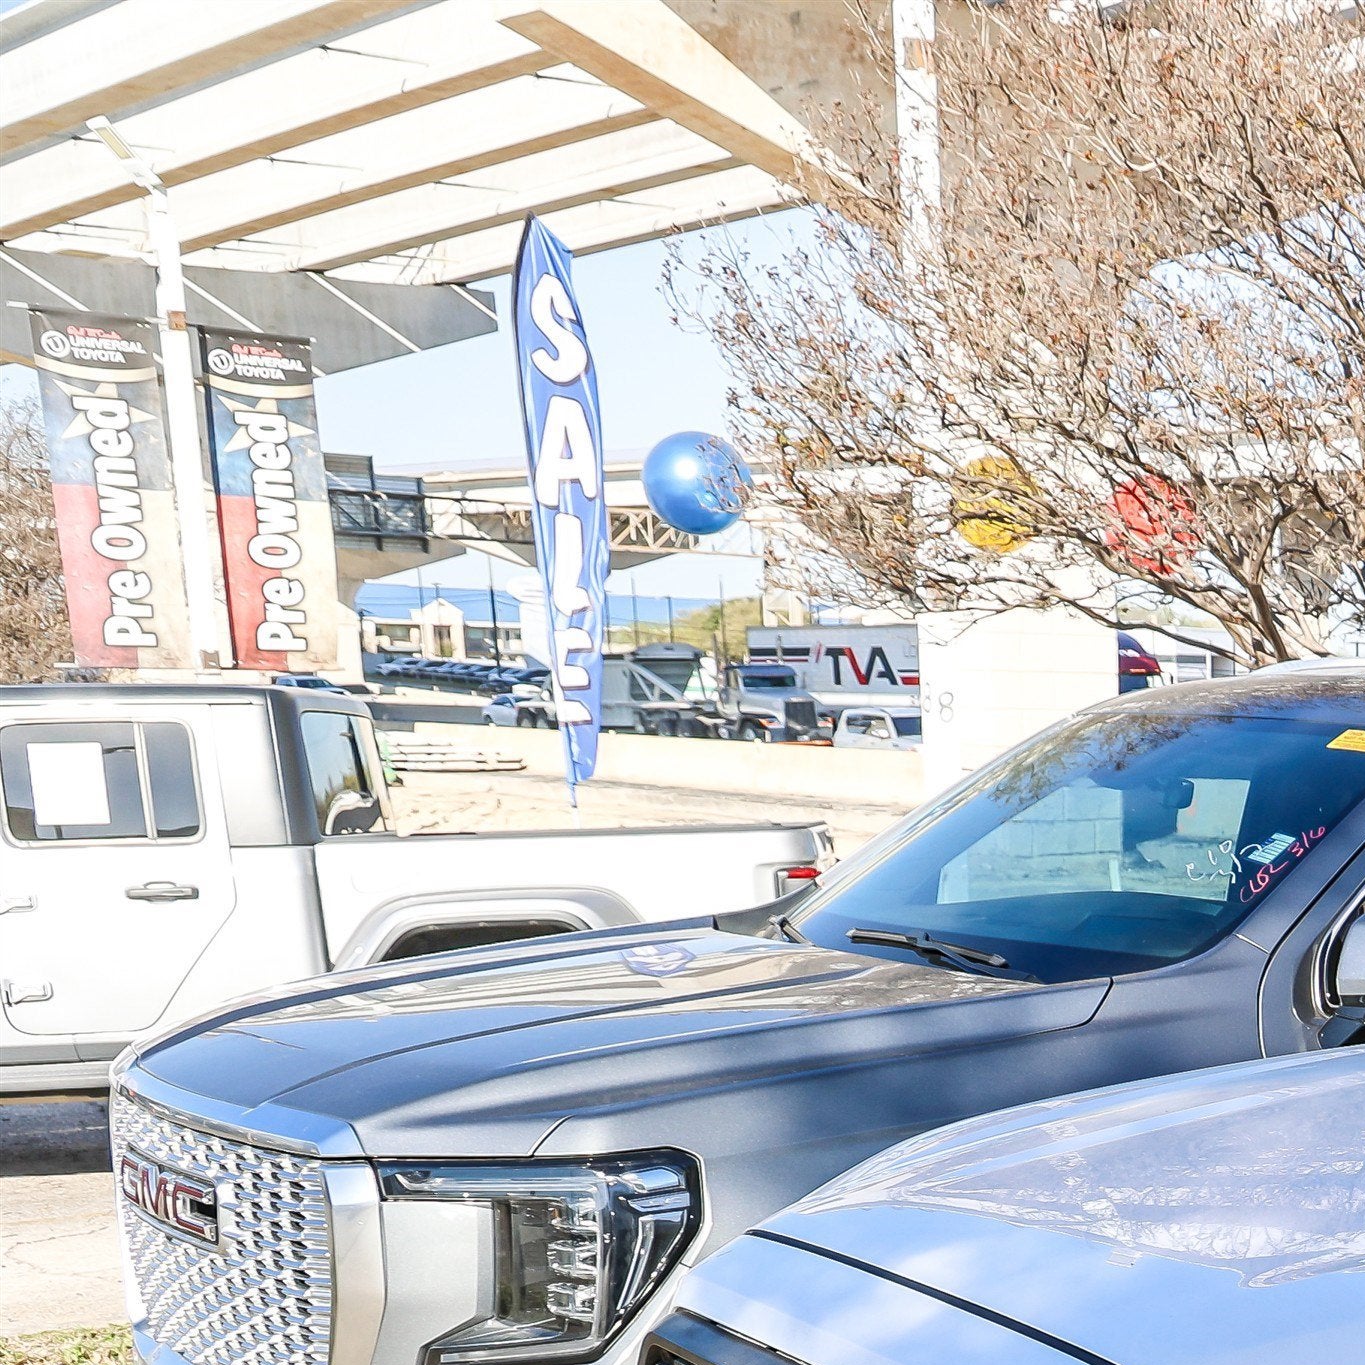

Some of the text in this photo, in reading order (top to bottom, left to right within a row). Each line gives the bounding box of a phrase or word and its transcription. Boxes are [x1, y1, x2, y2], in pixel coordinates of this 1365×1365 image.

[68, 334, 148, 354] UNIVERSAL
[70, 347, 127, 364] TOYOTA
[232, 352, 307, 373] UNIVERSAL
[234, 364, 287, 381] TOYOTA
[71, 394, 148, 561] Owned
[233, 409, 302, 569] Owned
[102, 569, 158, 648] Pre
[256, 576, 309, 652] Pre
[824, 646, 899, 686] TVA
[121, 1153, 213, 1241] GMC
